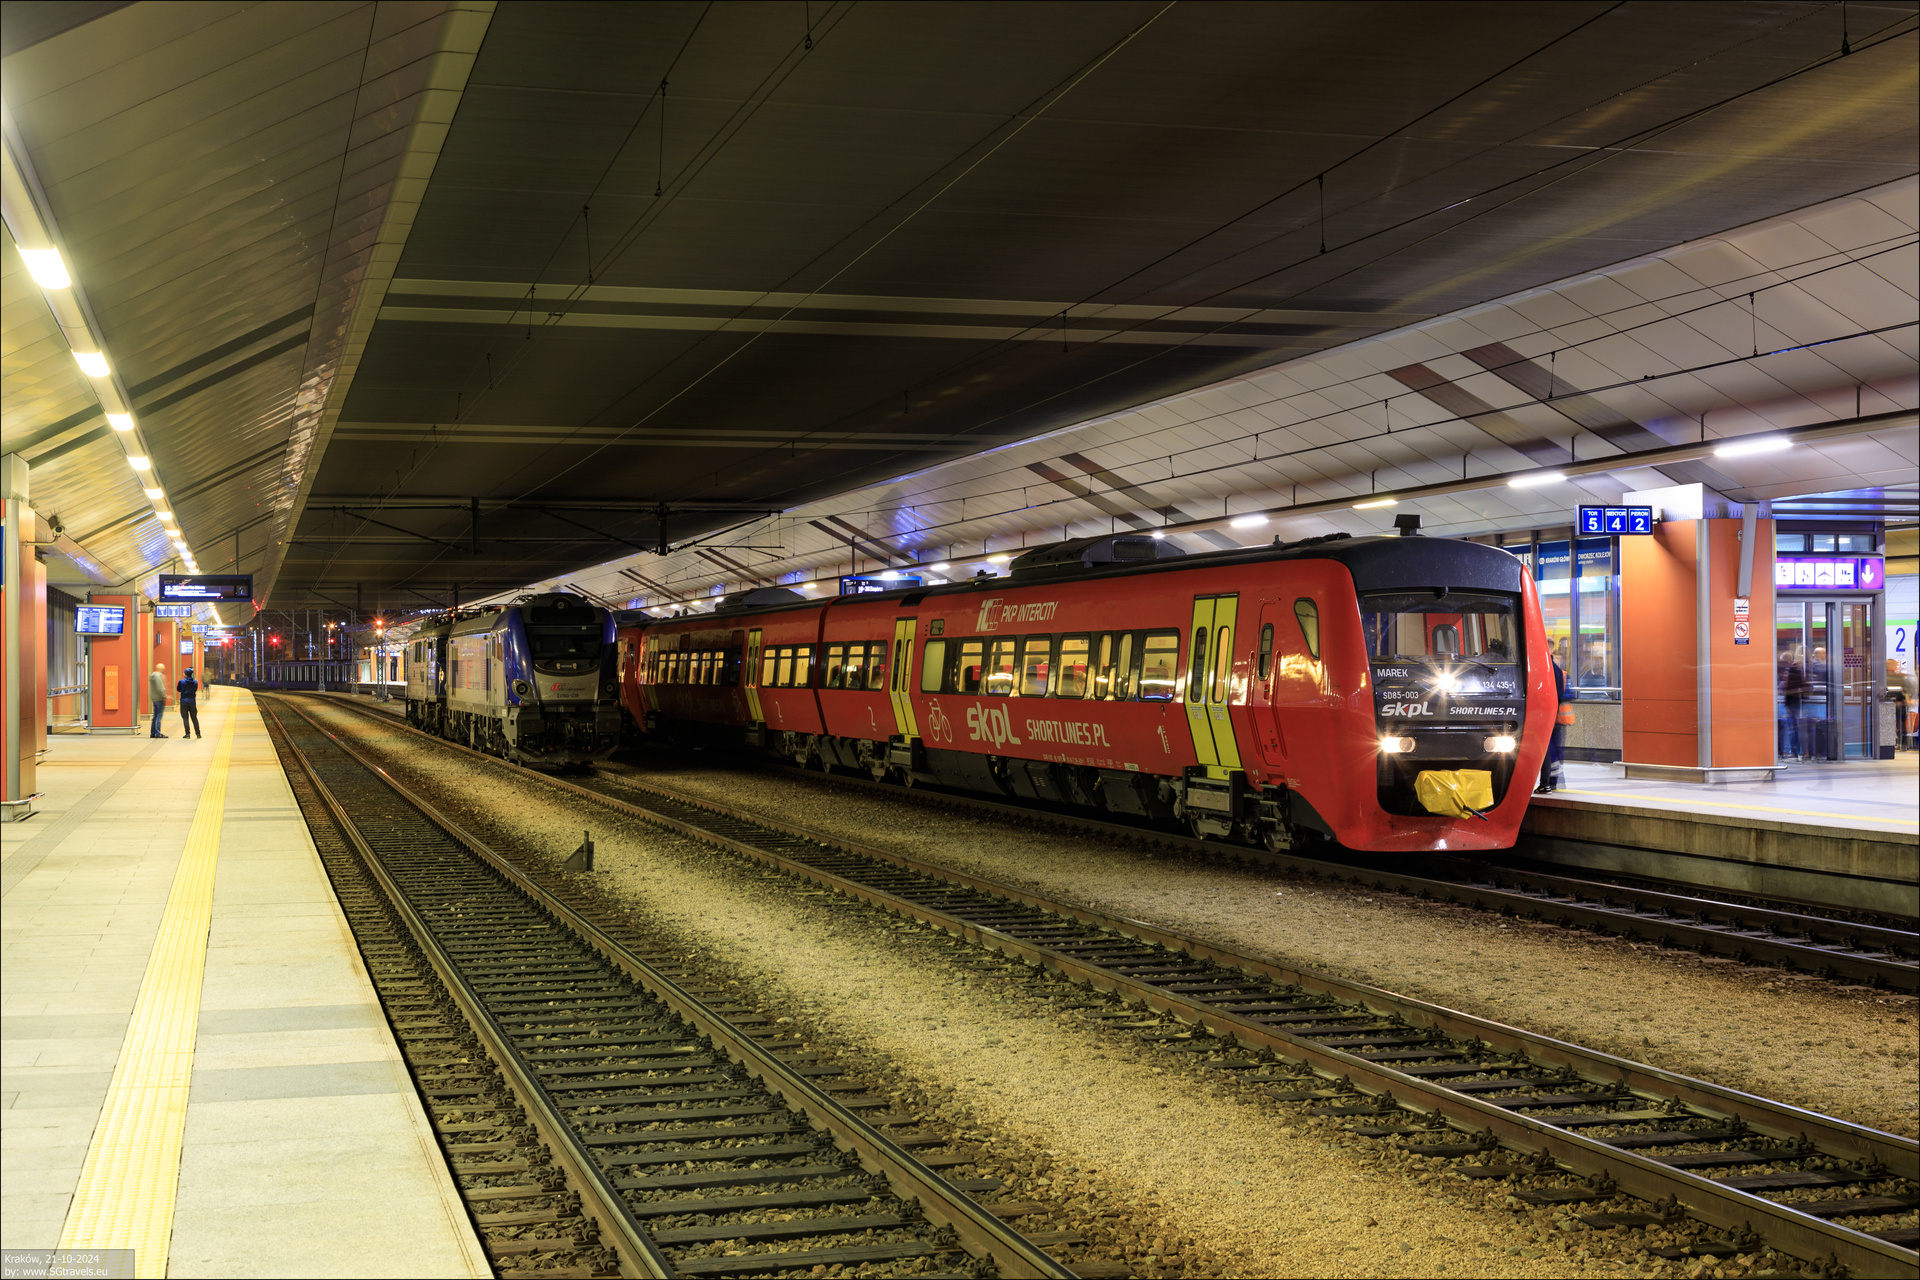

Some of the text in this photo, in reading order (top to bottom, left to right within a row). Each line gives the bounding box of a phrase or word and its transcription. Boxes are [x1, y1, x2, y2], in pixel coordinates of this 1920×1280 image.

[1588, 517, 1645, 531] 5 4 2
[1001, 605, 1018, 622] PKP
[1017, 601, 1059, 621] INTERCITY
[1896, 627, 1906, 652] 2
[1377, 668, 1409, 677] MAREK
[1482, 681, 1516, 689] 134 435-1
[1383, 691, 1419, 699] SD85-003
[1449, 707, 1518, 716] SHORTLINES.PL
[1026, 719, 1111, 748] SHORTLINES.PL
